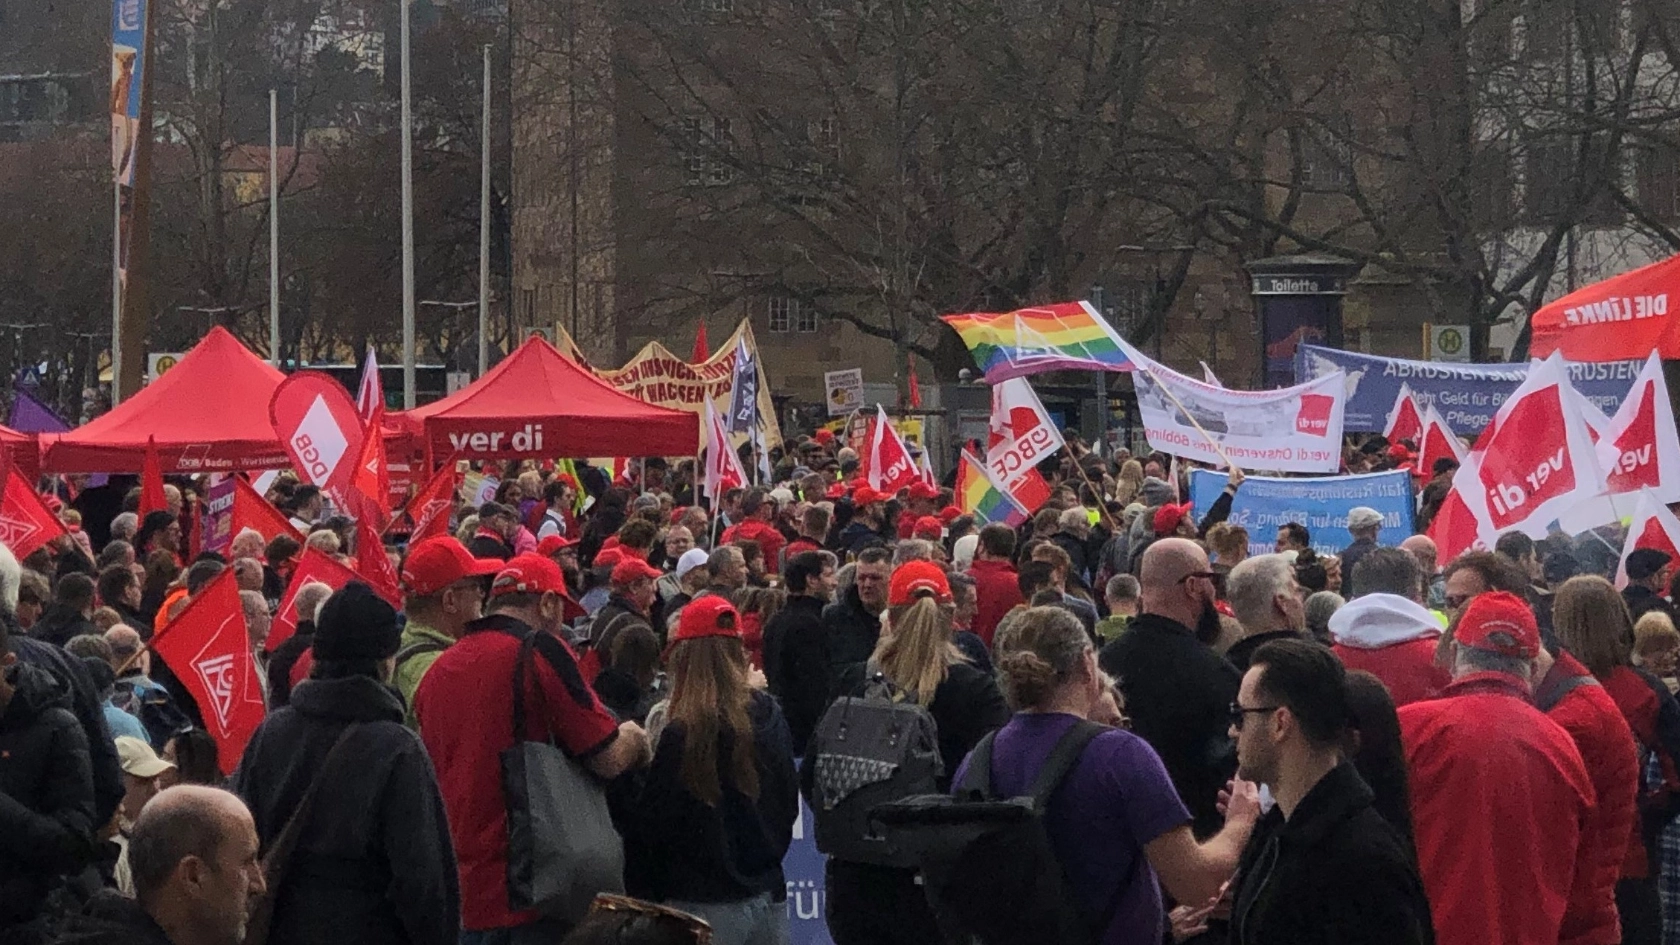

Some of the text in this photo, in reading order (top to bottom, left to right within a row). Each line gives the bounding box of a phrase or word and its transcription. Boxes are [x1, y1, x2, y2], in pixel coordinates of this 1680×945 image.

[1270, 279, 1319, 292] Toilette
[1440, 391, 1469, 405] Geld
[1472, 391, 1489, 406] für
[786, 878, 826, 920] fü
